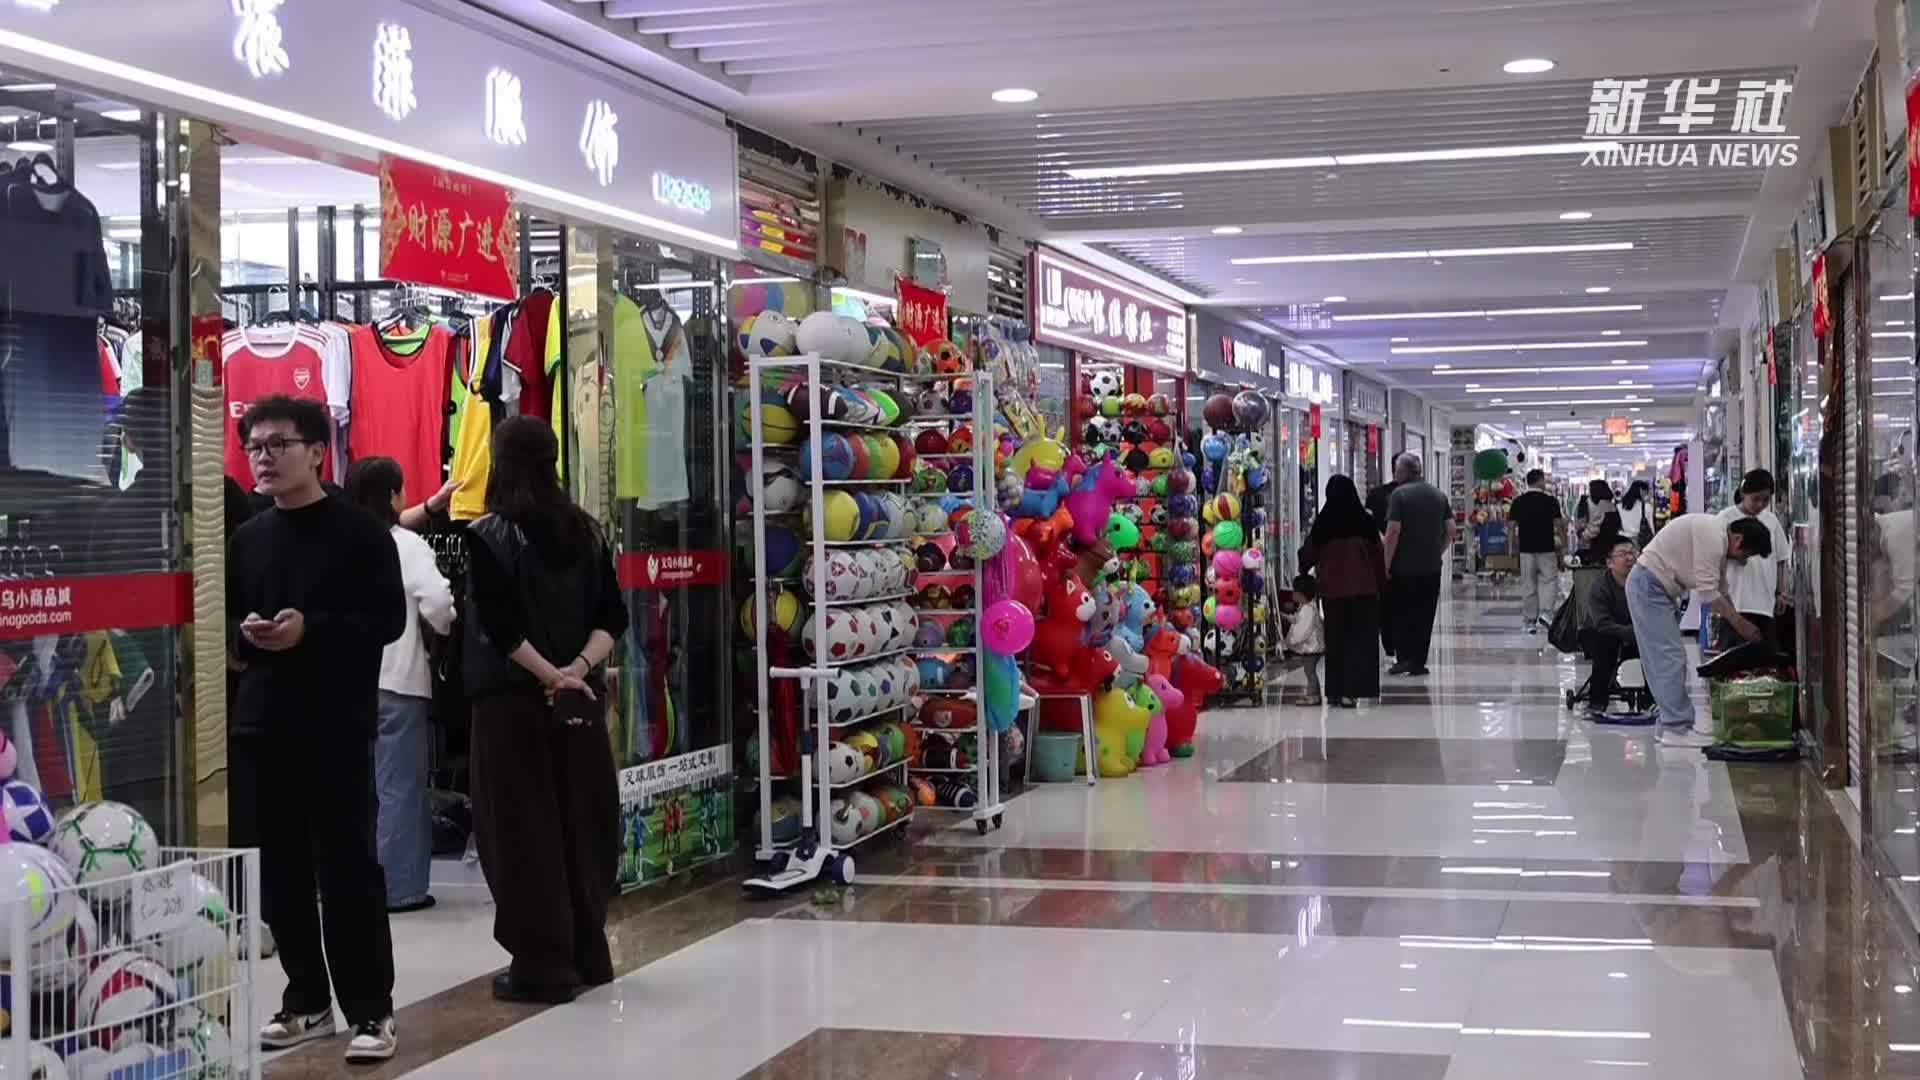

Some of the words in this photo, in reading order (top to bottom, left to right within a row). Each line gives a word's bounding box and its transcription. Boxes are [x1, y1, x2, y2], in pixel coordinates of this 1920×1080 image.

[408, 200, 498, 261] 财源广进
[1, 587, 72, 609] 乌小商品城
